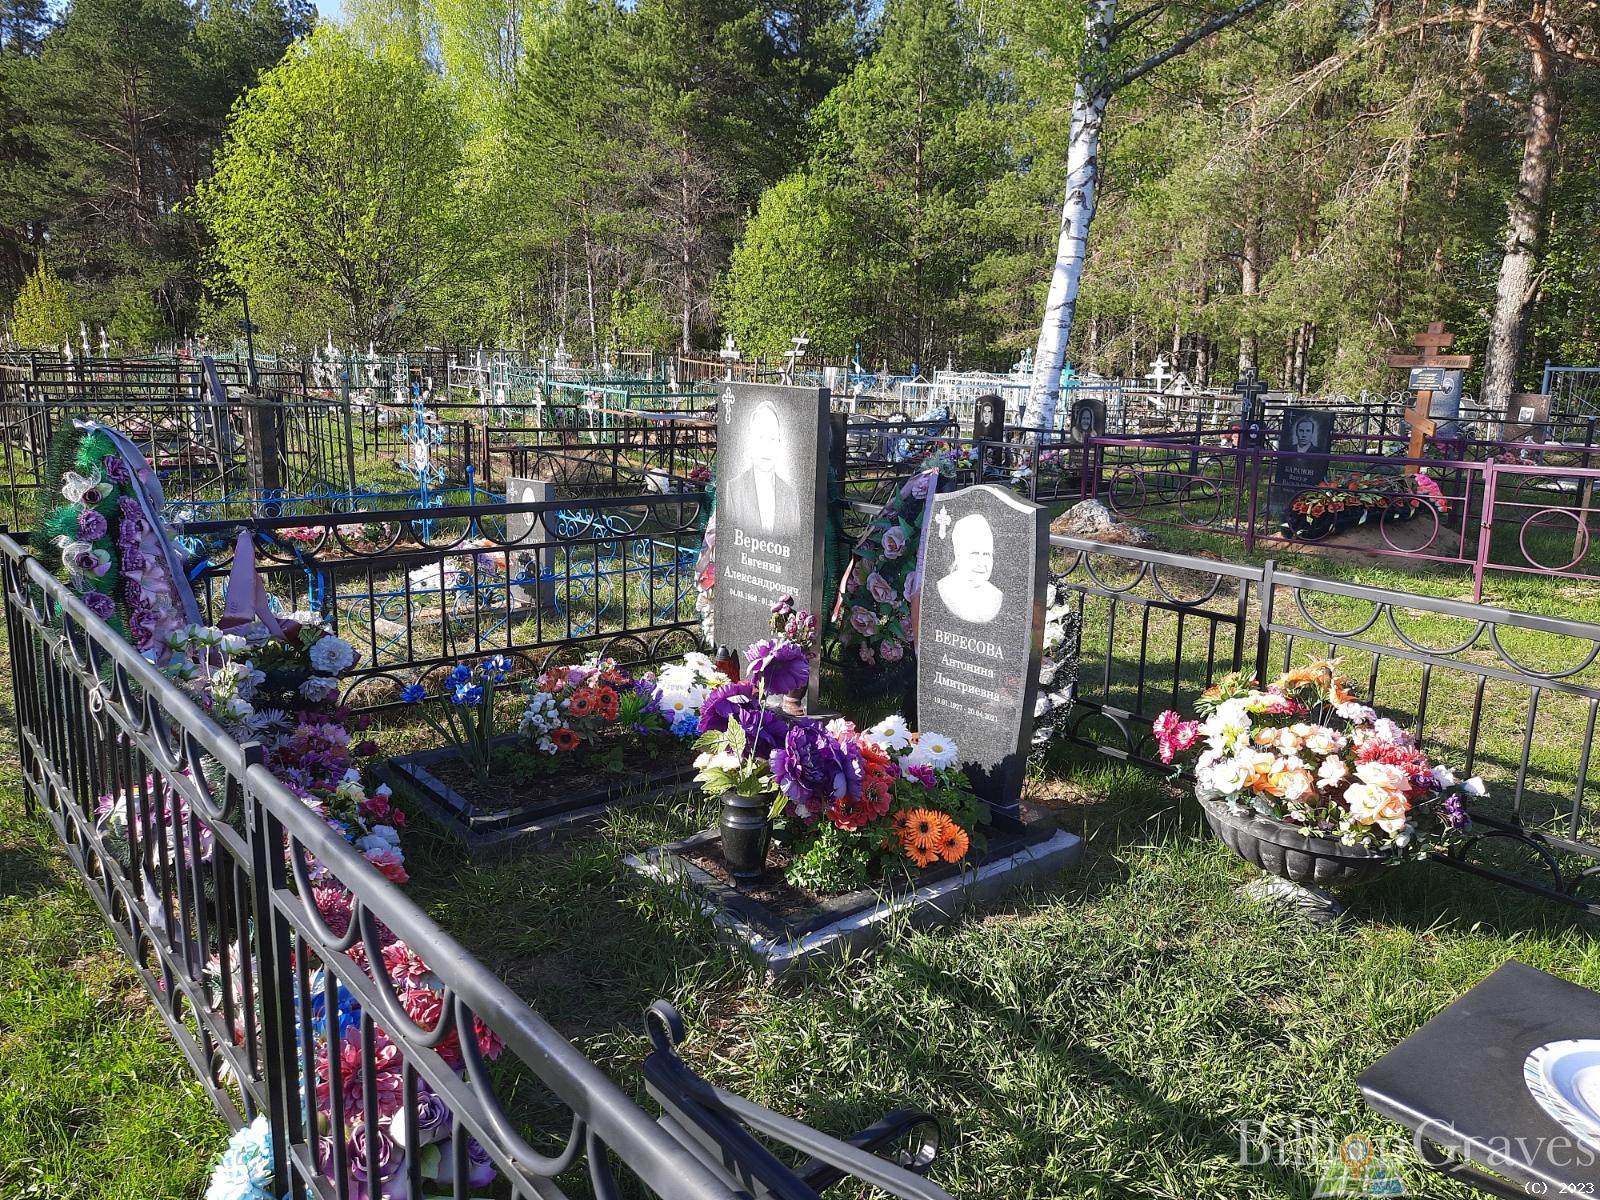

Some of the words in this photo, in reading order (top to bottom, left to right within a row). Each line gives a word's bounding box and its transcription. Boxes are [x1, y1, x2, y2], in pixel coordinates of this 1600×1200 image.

[734, 529, 791, 557] Вересов
[741, 552, 782, 574] Евгений
[724, 566, 799, 596] Александрович
[935, 630, 1004, 659] ВЕРЕСОВА
[941, 654, 994, 678] Антонина
[934, 672, 1001, 701] Дмитриевна
